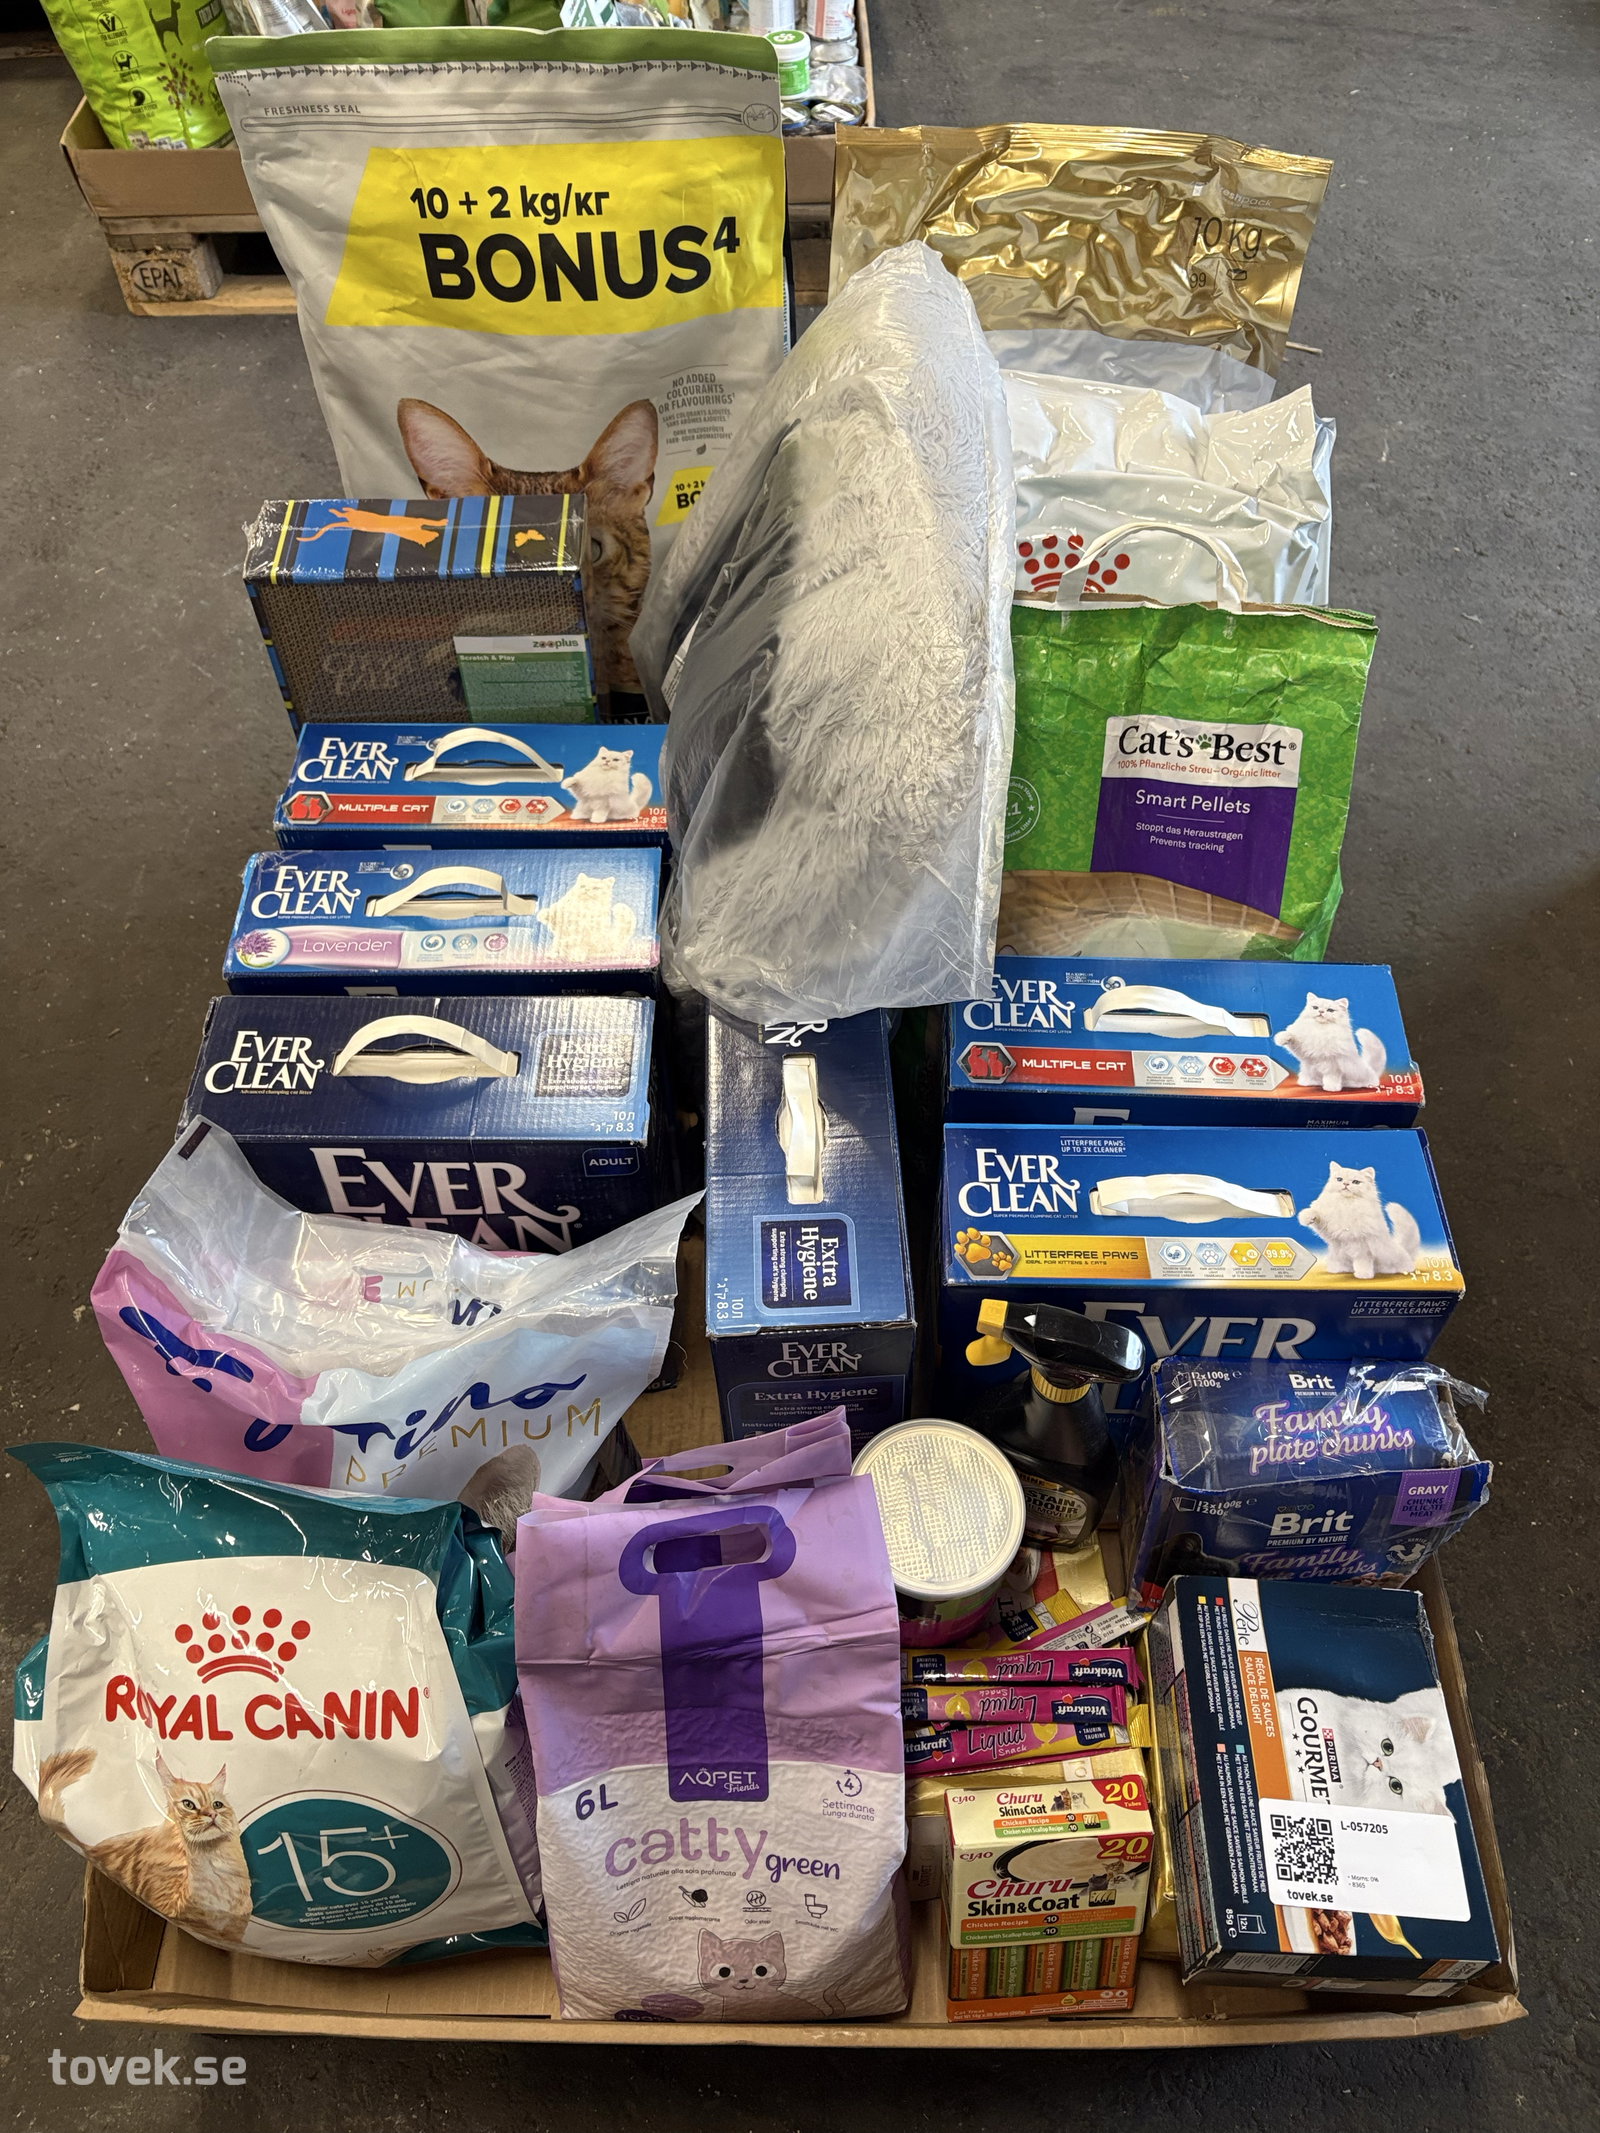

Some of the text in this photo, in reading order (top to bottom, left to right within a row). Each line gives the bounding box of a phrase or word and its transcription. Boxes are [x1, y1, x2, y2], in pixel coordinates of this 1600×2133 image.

[264, 104, 361, 116] FRESHNESS SEAL
[410, 187, 449, 219] 10
[488, 186, 511, 219] 2
[1194, 216, 1262, 260] 10 kg
[672, 373, 716, 388] NO ADDED
[666, 383, 725, 401] COLOURANTS
[658, 402, 670, 415] OR
[532, 638, 579, 650] zooplus
[319, 737, 399, 765] EVER
[1118, 725, 1194, 758] Cat's
[297, 759, 394, 783] CLEAN
[1117, 760, 1138, 770] 100%
[1139, 759, 1187, 773] Pflanzliche
[1259, 768, 1281, 778] litter
[338, 804, 429, 812] MULTIPLE CAT
[1135, 789, 1251, 815] Smart Pellets
[1135, 822, 1243, 842] Stoppt das Heraustragen
[1149, 835, 1225, 854] Prevents tracking
[275, 865, 361, 897] EVER
[251, 890, 356, 919] CLEAN
[302, 939, 393, 954] Lavender
[963, 1001, 1072, 1031] CLEAN
[230, 1030, 325, 1070] EVER
[547, 1053, 624, 1072] Hygiene
[1022, 1058, 1127, 1071] MULTIPLE CAT
[204, 1060, 319, 1094] CLEAN
[1395, 1084, 1415, 1095] 8.3
[1060, 1139, 1102, 1147] LITTERFREE
[588, 1156, 634, 1169] ADULT
[976, 1148, 1081, 1190] EVER
[309, 1147, 581, 1223] EVER
[958, 1181, 1078, 1218] CLEAN
[779, 1248, 787, 1268] strong
[796, 1226, 821, 1300] Hygiene
[821, 1237, 839, 1287] Extra
[1024, 1250, 1139, 1260] LITTERFREE PAWS
[1265, 1248, 1293, 1259] 99.9%
[779, 1268, 788, 1297] clumping
[1351, 1307, 1365, 1315] UP
[1353, 1300, 1416, 1308] LITTERFREE
[781, 1341, 863, 1361] EVER
[767, 1358, 860, 1378] CLEAN
[1288, 1372, 1336, 1391] Brit
[753, 1387, 878, 1401] Extra Hygiene
[1254, 1402, 1388, 1434] Family
[1252, 1427, 1414, 1474] plate chunks
[1027, 1488, 1076, 1507] STAIN
[1407, 1485, 1449, 1496] GRAVY
[1401, 1504, 1443, 1513] DELICATE
[1406, 1497, 1445, 1506] CHUNKS
[1270, 1509, 1355, 1537] Brit
[1409, 1510, 1433, 1518] MEAT
[1266, 1534, 1349, 1547] PREMIUM BY NATURE
[1243, 1546, 1366, 1574] Family
[995, 1653, 1055, 1682] Liquid
[996, 1655, 1025, 1663] Snack
[1075, 1667, 1124, 1679] Vitakraft
[979, 1688, 1008, 1697] Snack
[1244, 1657, 1262, 1725] SAUCE DELIGHT
[1255, 1658, 1275, 1737] RÉGAL DE SAUCES
[979, 1688, 1038, 1722] Liquid
[1057, 1704, 1108, 1716] Vitakraft
[1082, 1727, 1102, 1735] TAURIN
[1084, 1732, 1107, 1740] TAURINE
[967, 1724, 1026, 1759] Liquid
[1297, 1696, 1331, 1804] GOURME
[999, 1746, 1027, 1757] Snack
[1325, 1740, 1339, 1780] PURINA
[723, 1782, 760, 1794] Friends
[1104, 1781, 1140, 1803] 20
[822, 1798, 875, 1815] Settimane
[996, 1792, 1043, 1806] Churu
[822, 1808, 875, 1822] Lunga durata
[998, 1804, 1048, 1818] Skin&Coat
[1001, 1817, 1050, 1827] Chicken Recipe
[1341, 1820, 1389, 1835] L-057205
[604, 1817, 769, 1880] catty
[1100, 1836, 1149, 1859] 20
[258, 1826, 409, 1902] 15+
[765, 1853, 841, 1883] green
[616, 1876, 640, 1891] Lettiera
[640, 1870, 670, 1883] naturale
[671, 1867, 684, 1876] alla
[700, 1868, 737, 1878] profumata
[967, 1877, 1073, 1900] Churu
[967, 1893, 1080, 1918] Skin&Coat
[1286, 1888, 1334, 1905] tovek.se
[966, 1919, 1030, 1929] Chicken Recipe
[1225, 1908, 1234, 1925] 85g
[1240, 1918, 1248, 1930] 12x
